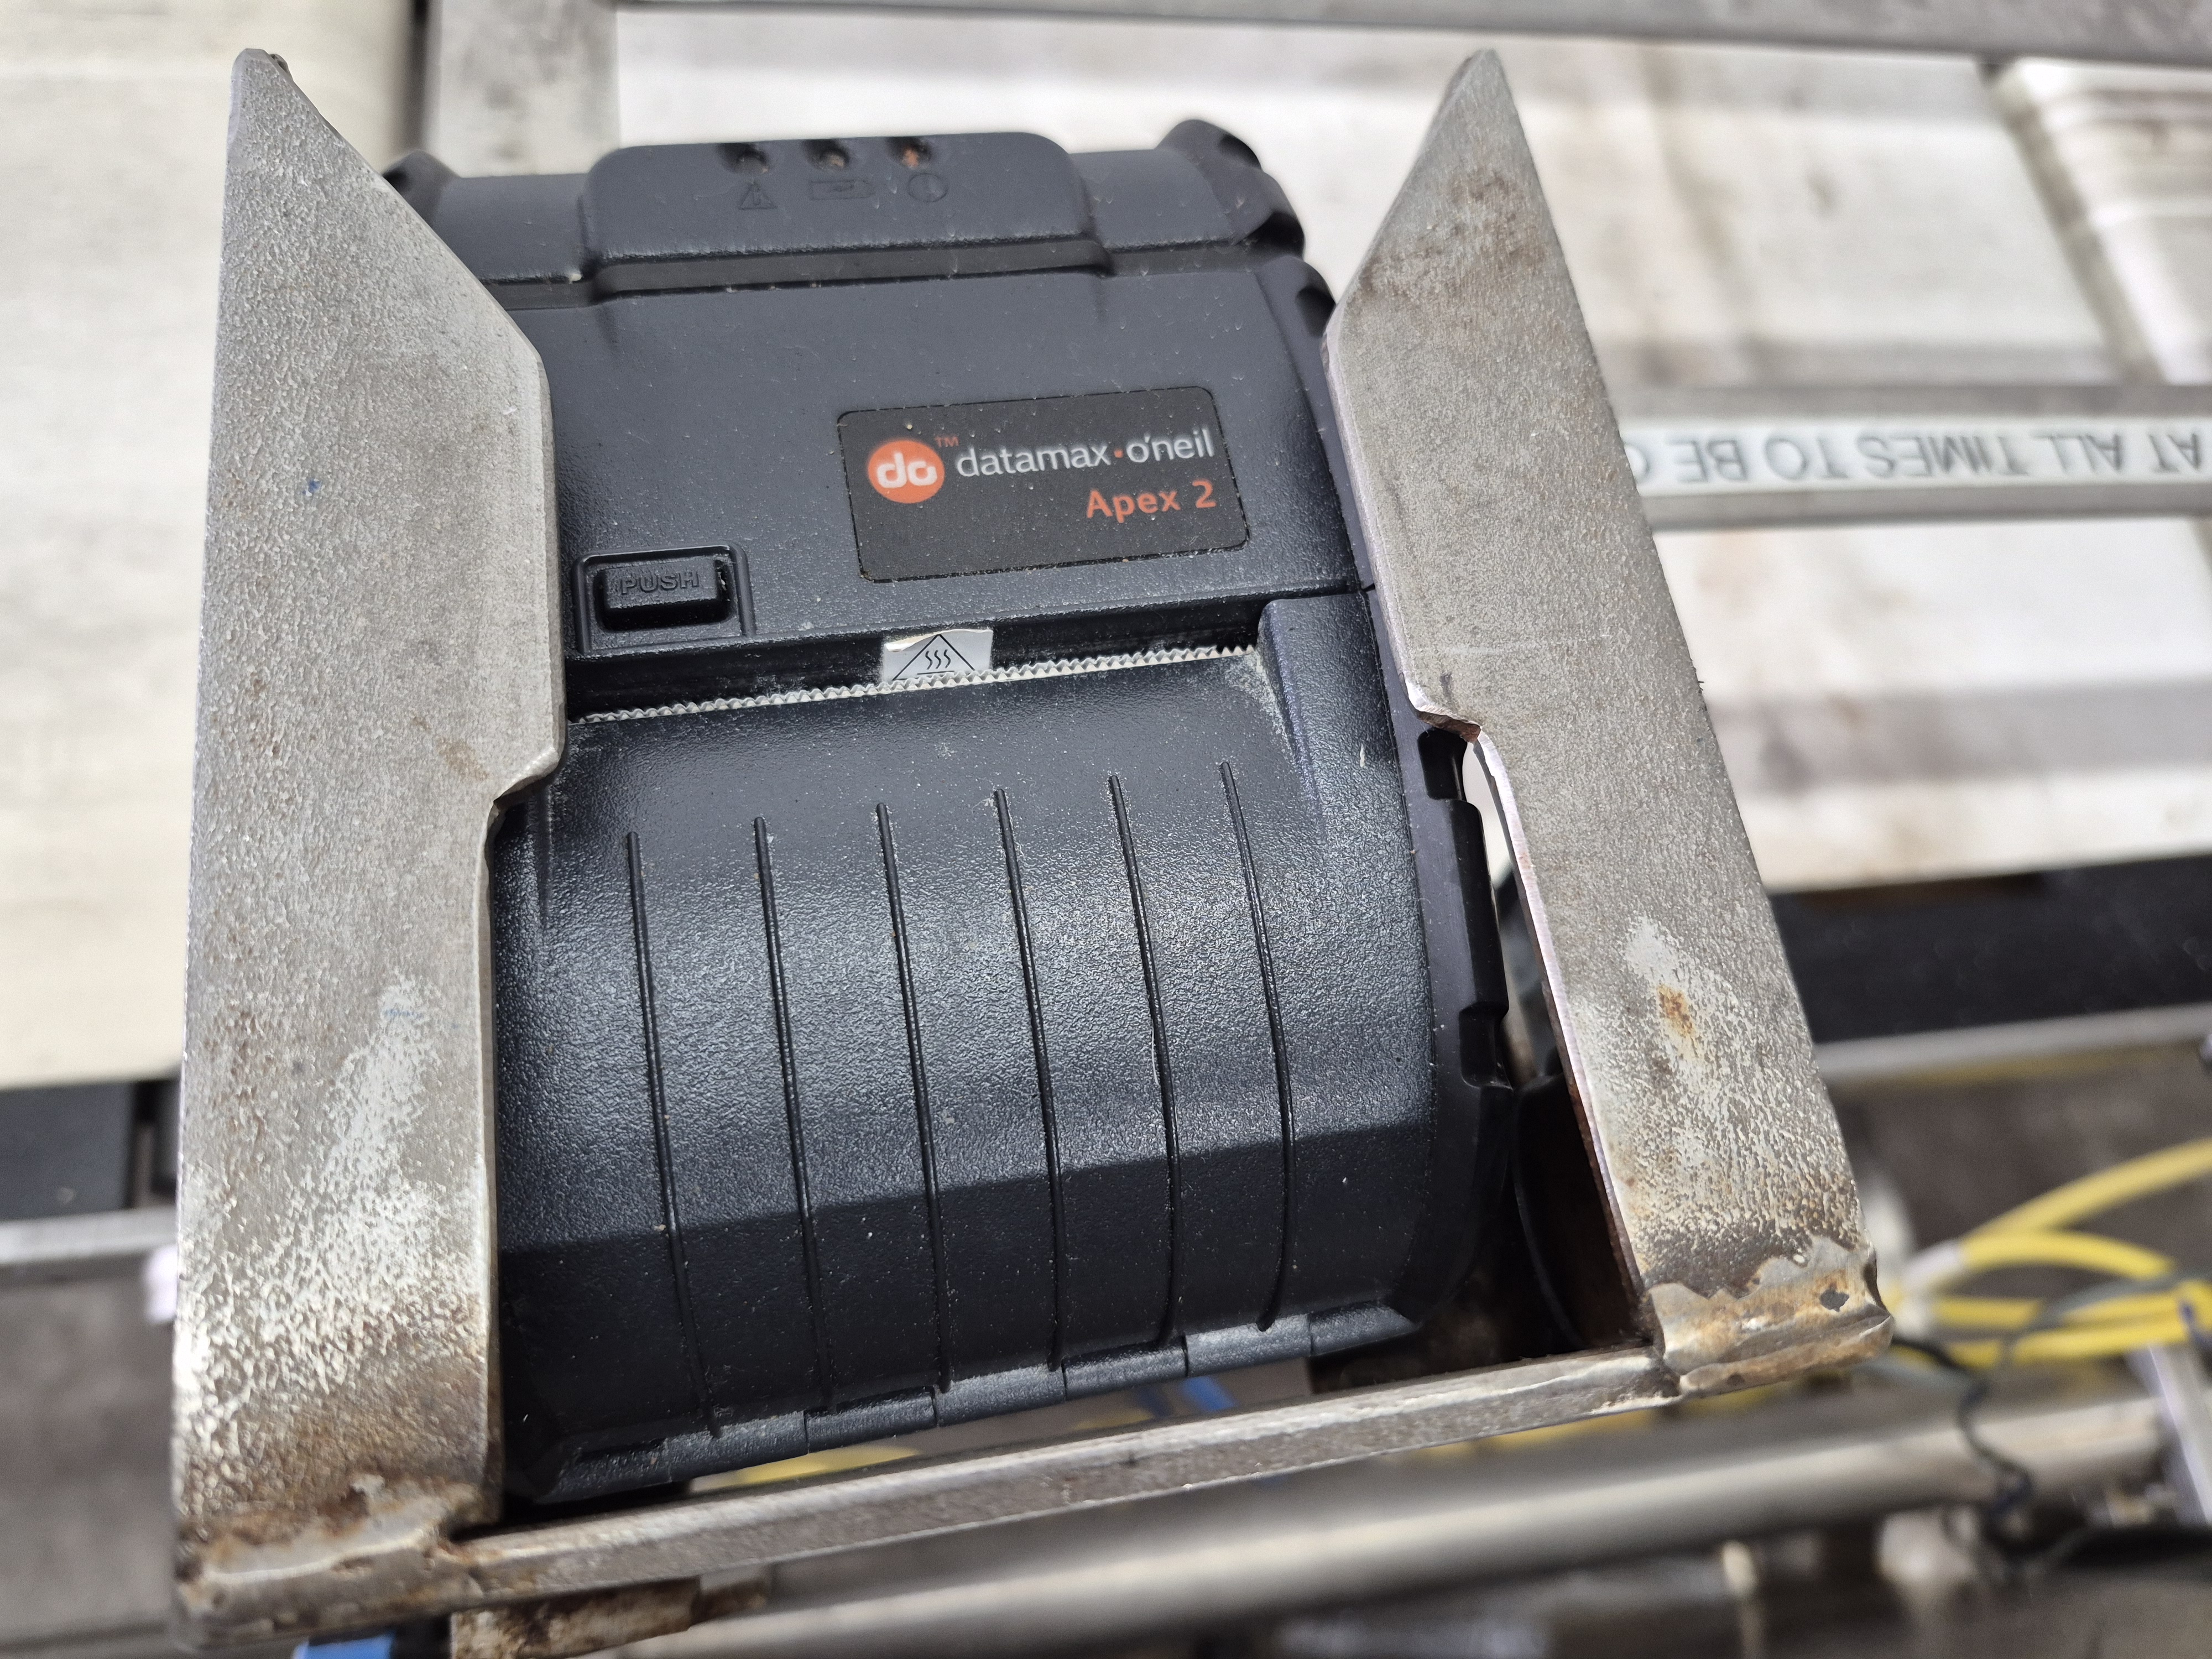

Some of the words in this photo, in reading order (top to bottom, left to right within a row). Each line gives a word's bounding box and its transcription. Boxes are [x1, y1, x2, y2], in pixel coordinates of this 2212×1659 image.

[1666, 437, 1748, 482] BE
[1762, 435, 1848, 480] TO
[1856, 434, 2031, 479] TIMES
[2030, 431, 2125, 474] ALL
[2148, 431, 2203, 473] AT
[1086, 489, 1181, 523] Apex
[1192, 479, 1217, 508] 2
[620, 572, 700, 595] PUSH
